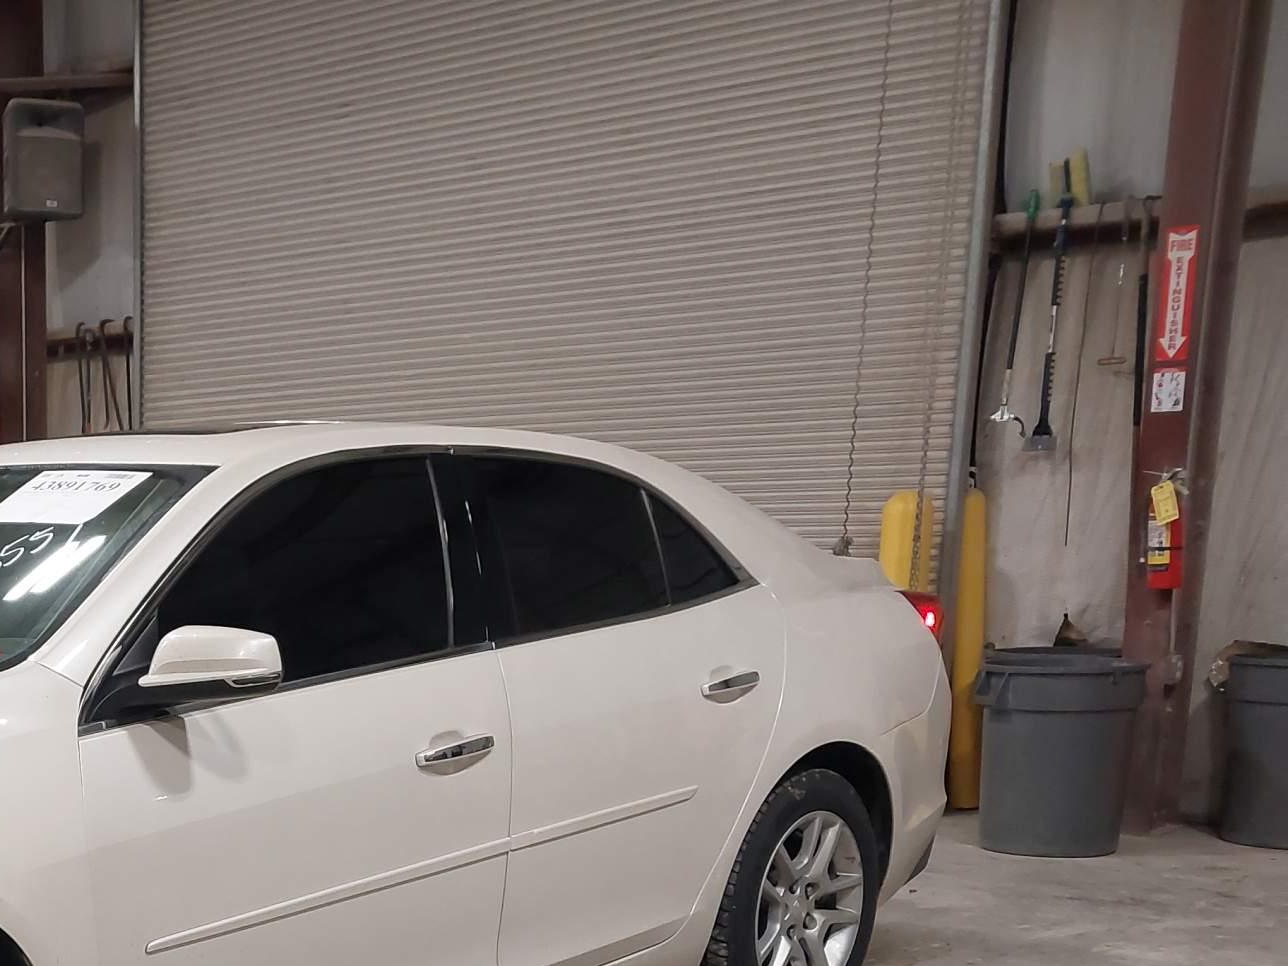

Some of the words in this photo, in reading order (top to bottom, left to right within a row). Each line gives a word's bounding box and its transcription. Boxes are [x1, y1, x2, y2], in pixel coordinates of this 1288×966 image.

[1170, 237, 1194, 253] FIRE
[1167, 255, 1184, 351] EXTINGUISHER
[32, 480, 121, 492] 43891769
